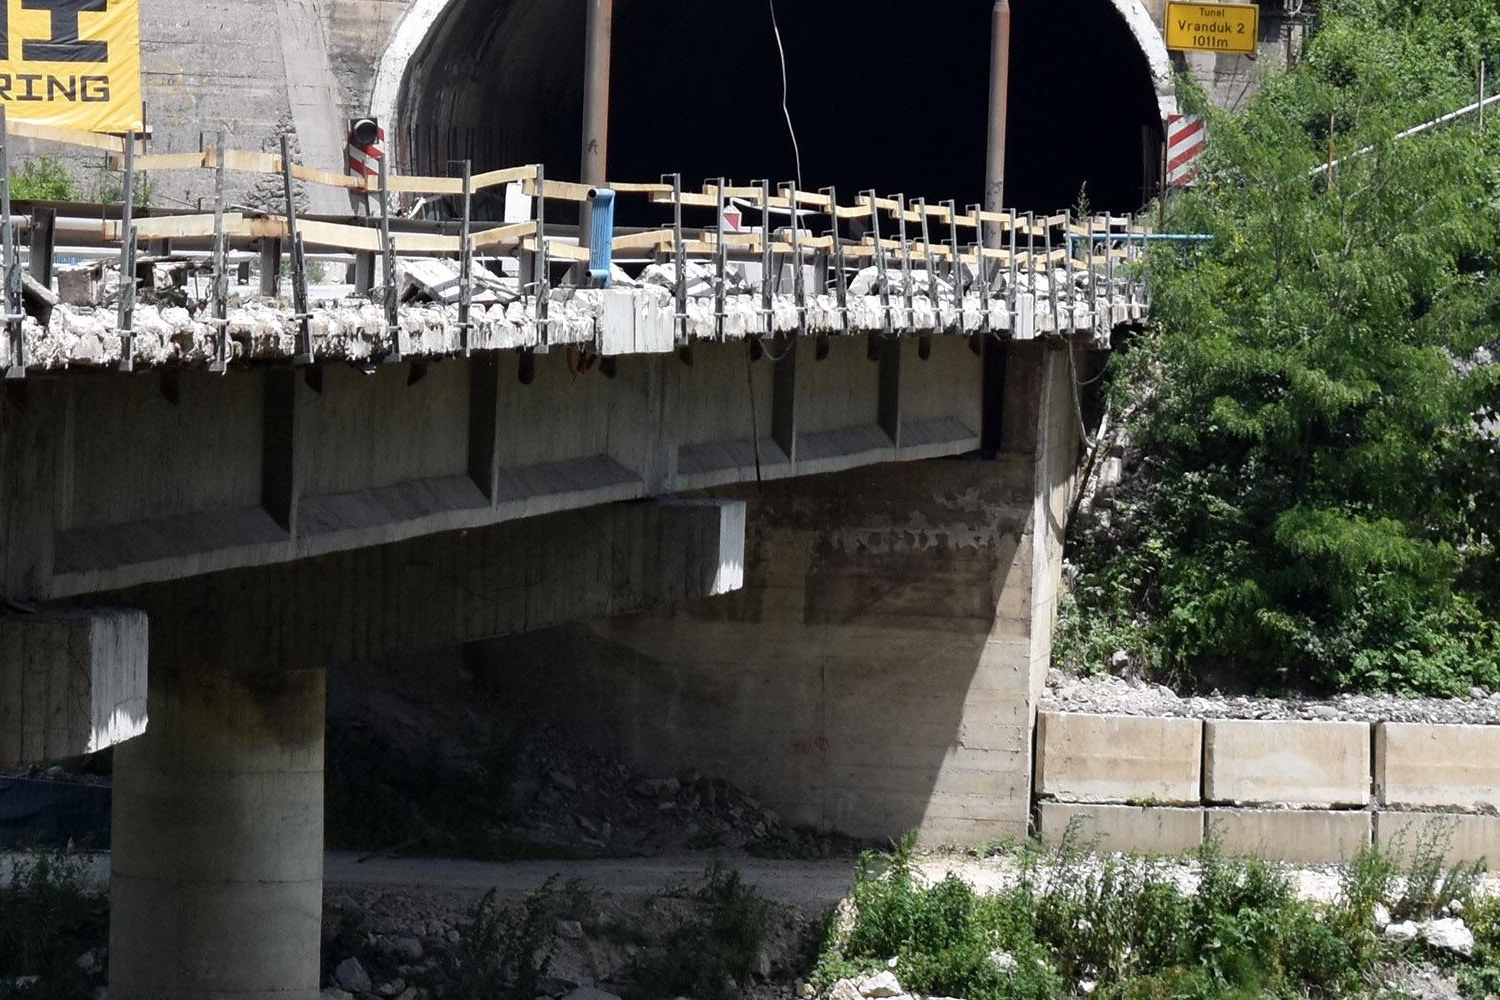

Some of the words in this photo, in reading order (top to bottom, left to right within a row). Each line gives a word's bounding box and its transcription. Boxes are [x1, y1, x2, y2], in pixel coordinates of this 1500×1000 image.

[1199, 7, 1226, 17] Tunel
[1178, 20, 1232, 34] Vranduk
[1236, 22, 1245, 35] 2
[1193, 35, 1229, 48] 1011m
